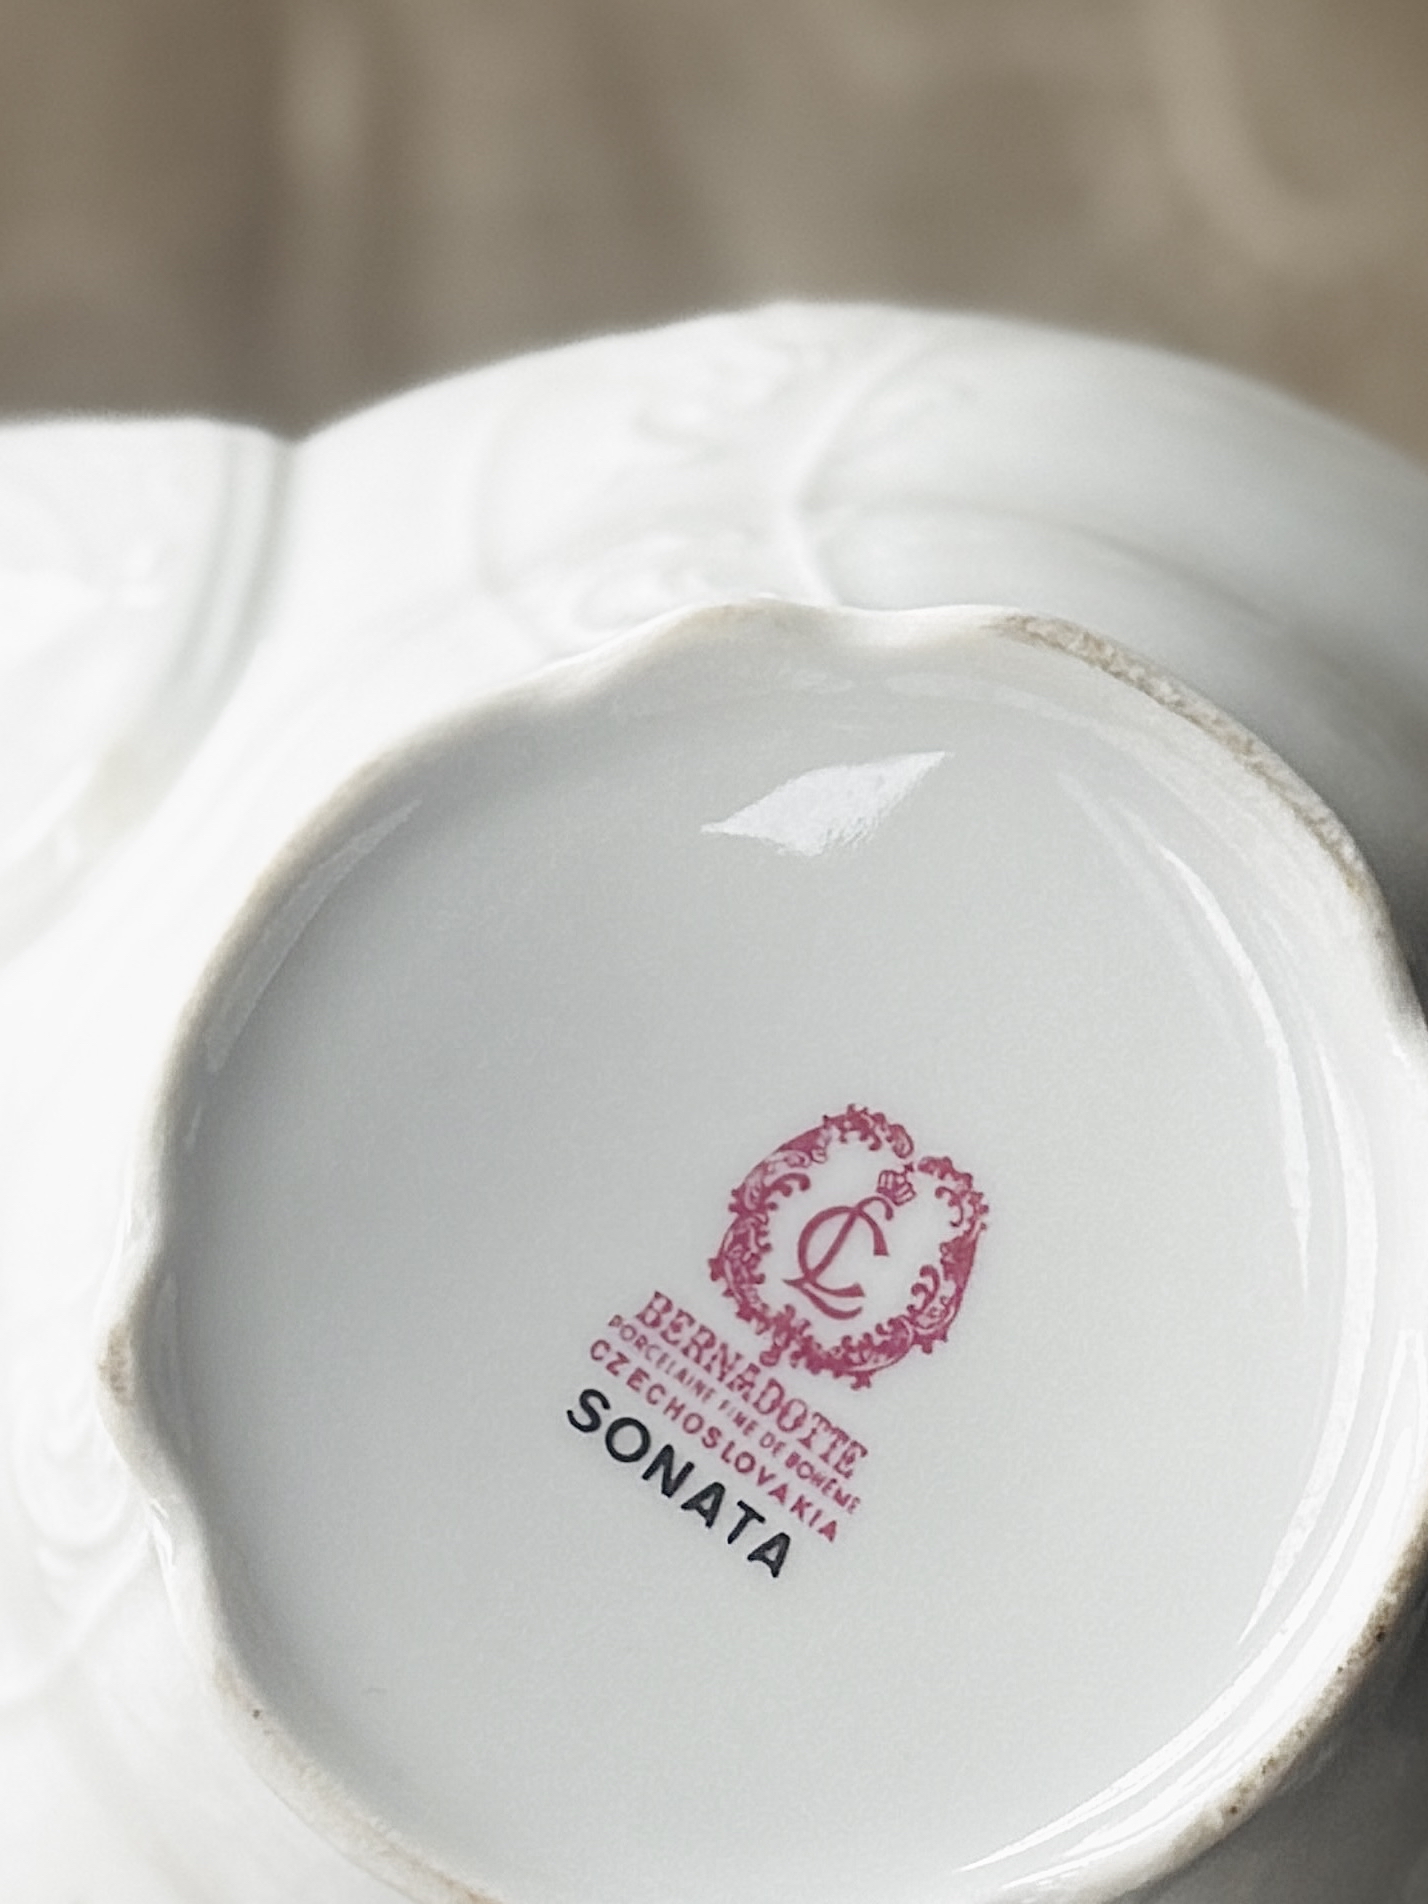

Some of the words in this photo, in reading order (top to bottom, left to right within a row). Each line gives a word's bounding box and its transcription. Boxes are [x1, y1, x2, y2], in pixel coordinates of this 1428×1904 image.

[589, 1338, 839, 1543] CZECHOSLOVAKIA
[635, 1290, 869, 1480] BERNADOTTE
[565, 1388, 792, 1579] SONATA
